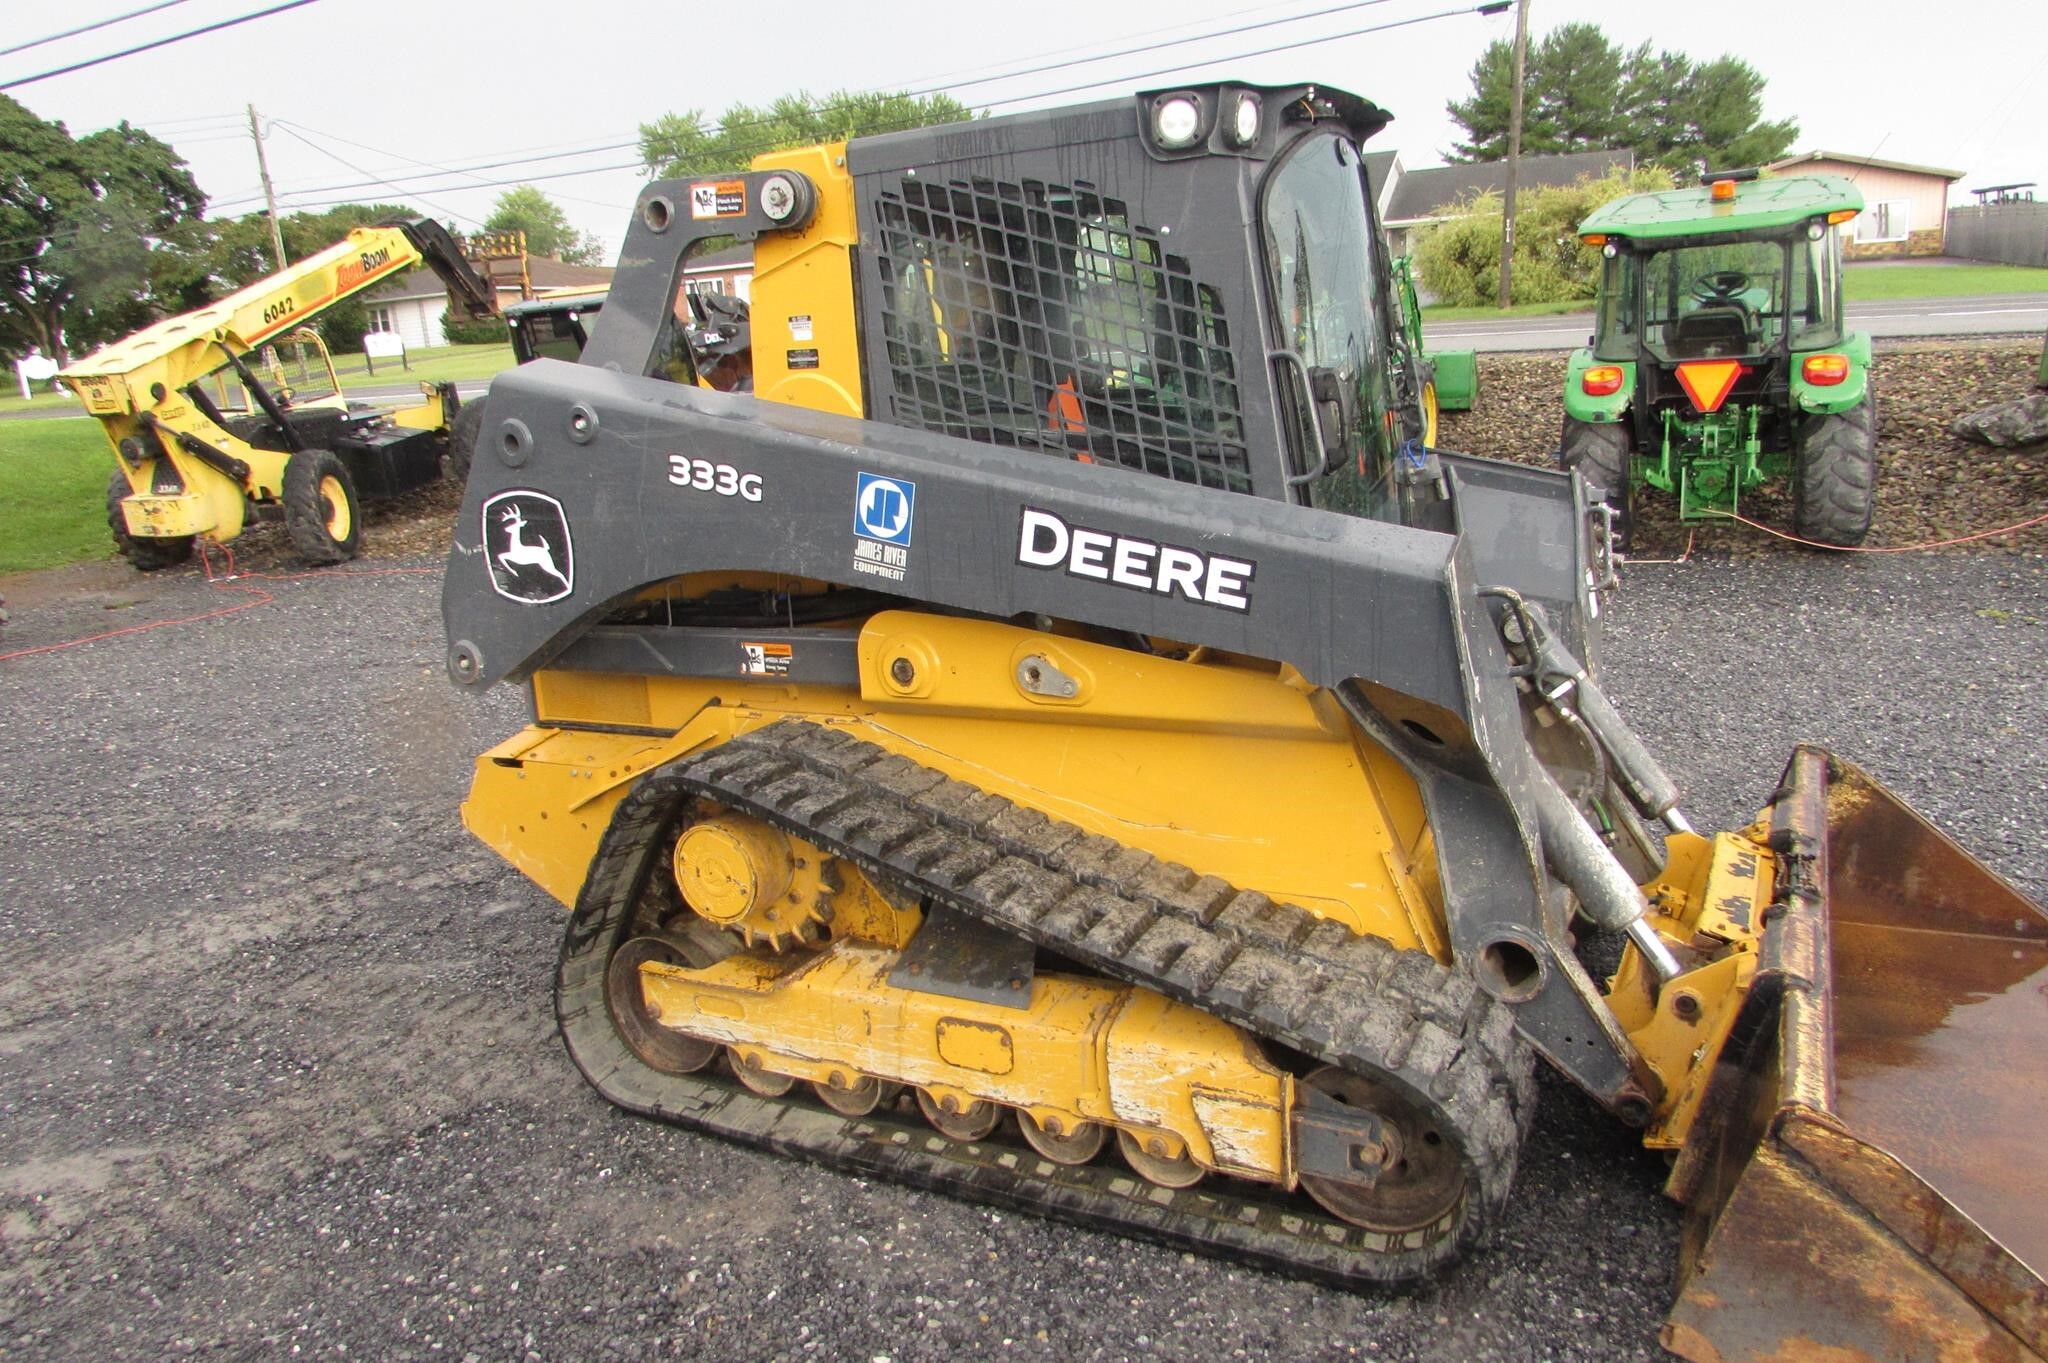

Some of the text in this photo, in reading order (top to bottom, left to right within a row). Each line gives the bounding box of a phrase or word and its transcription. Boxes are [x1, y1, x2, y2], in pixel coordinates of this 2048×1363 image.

[263, 297, 295, 325] 6042
[669, 454, 763, 502] 333G
[854, 539, 908, 568] JAMES RIVER
[1019, 510, 1252, 609] DEERE
[853, 560, 906, 582] EQUIPMENT
